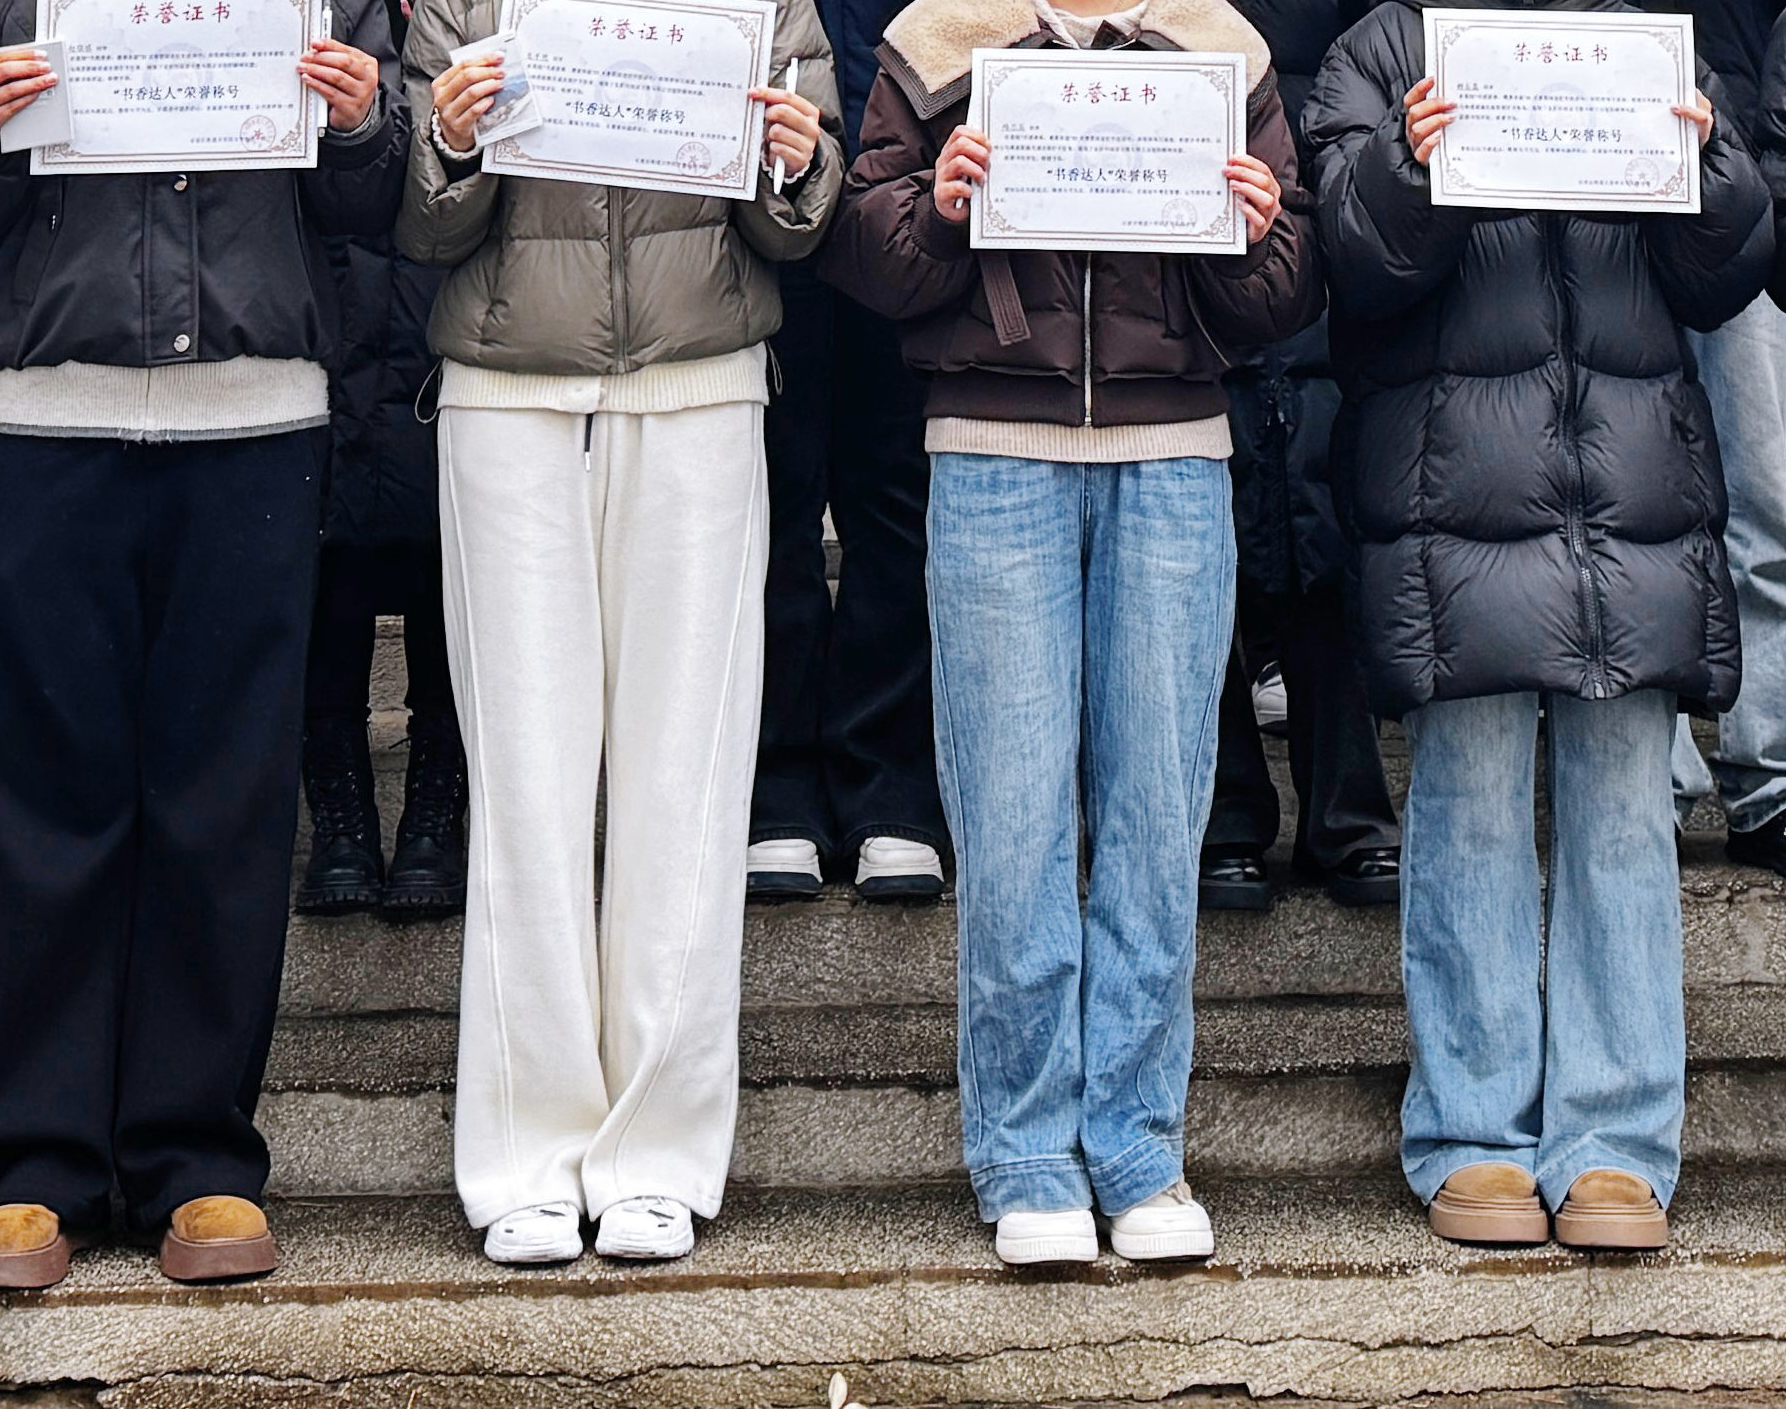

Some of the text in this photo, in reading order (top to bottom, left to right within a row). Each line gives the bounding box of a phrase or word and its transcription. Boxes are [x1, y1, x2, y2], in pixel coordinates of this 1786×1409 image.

[130, 1, 231, 24] 荣誉证书
[588, 17, 685, 45] 荣誉证书
[1513, 42, 1609, 64] 荣誉证书
[1060, 83, 1157, 105] 荣誉证书
